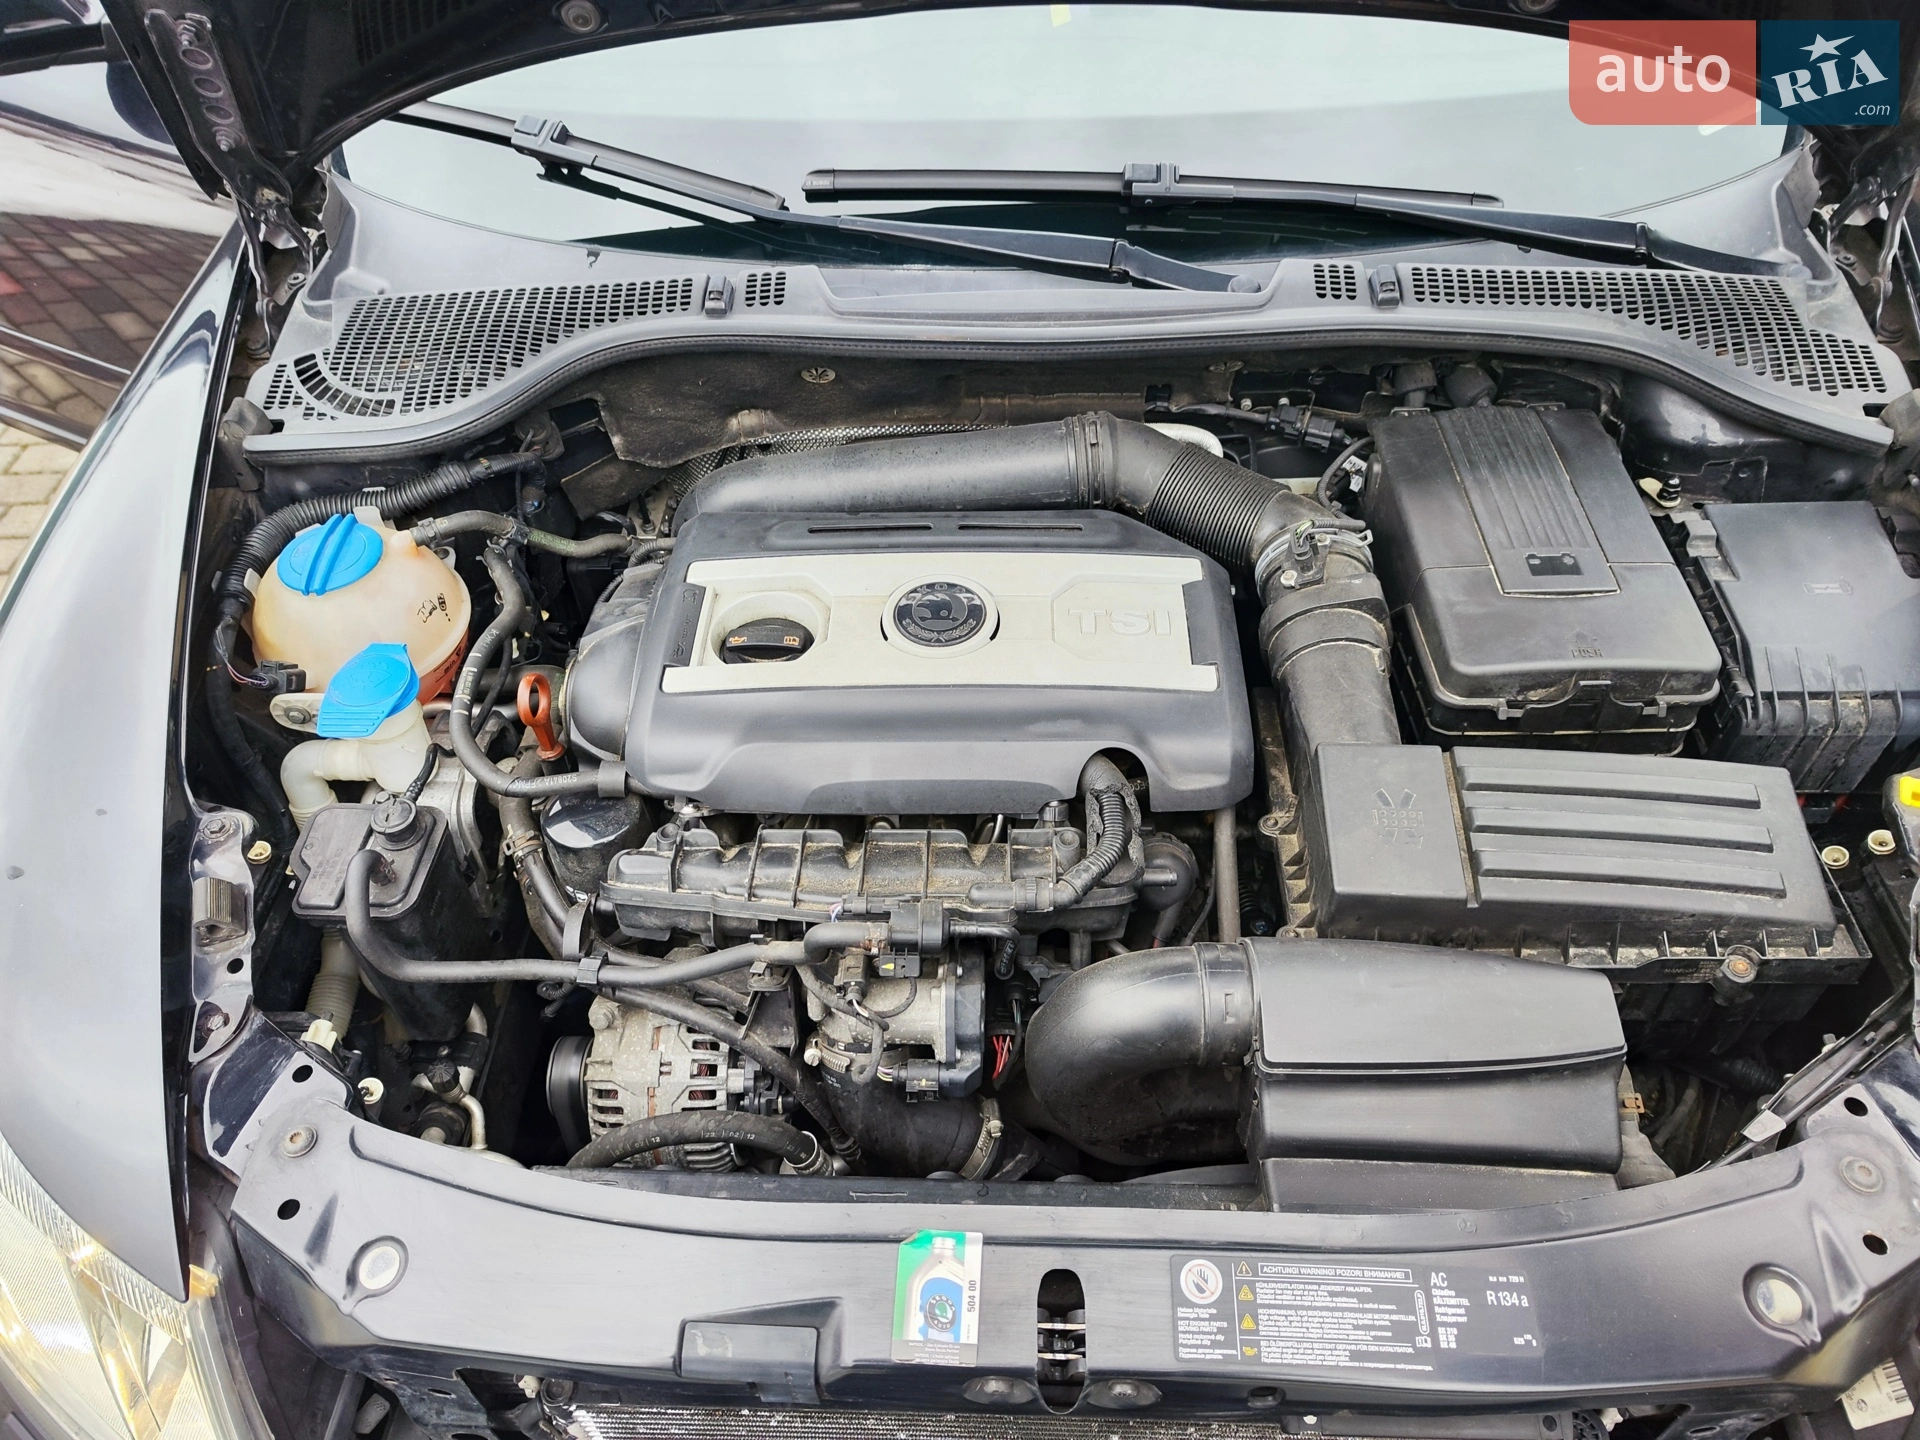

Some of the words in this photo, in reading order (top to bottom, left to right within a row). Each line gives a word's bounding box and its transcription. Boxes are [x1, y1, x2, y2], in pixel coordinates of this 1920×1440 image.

[1068, 609, 1171, 636] TSI
[1571, 649, 1603, 658] PUSH
[1263, 1266, 1299, 1275] ACHTUNG!
[1300, 1267, 1335, 1276] WARNING!
[1336, 1269, 1363, 1277] POZOR!
[1431, 1271, 1448, 1287] AC
[968, 1280, 977, 1292] 00
[967, 1295, 976, 1313] 504
[933, 1320, 951, 1329] AUTO
